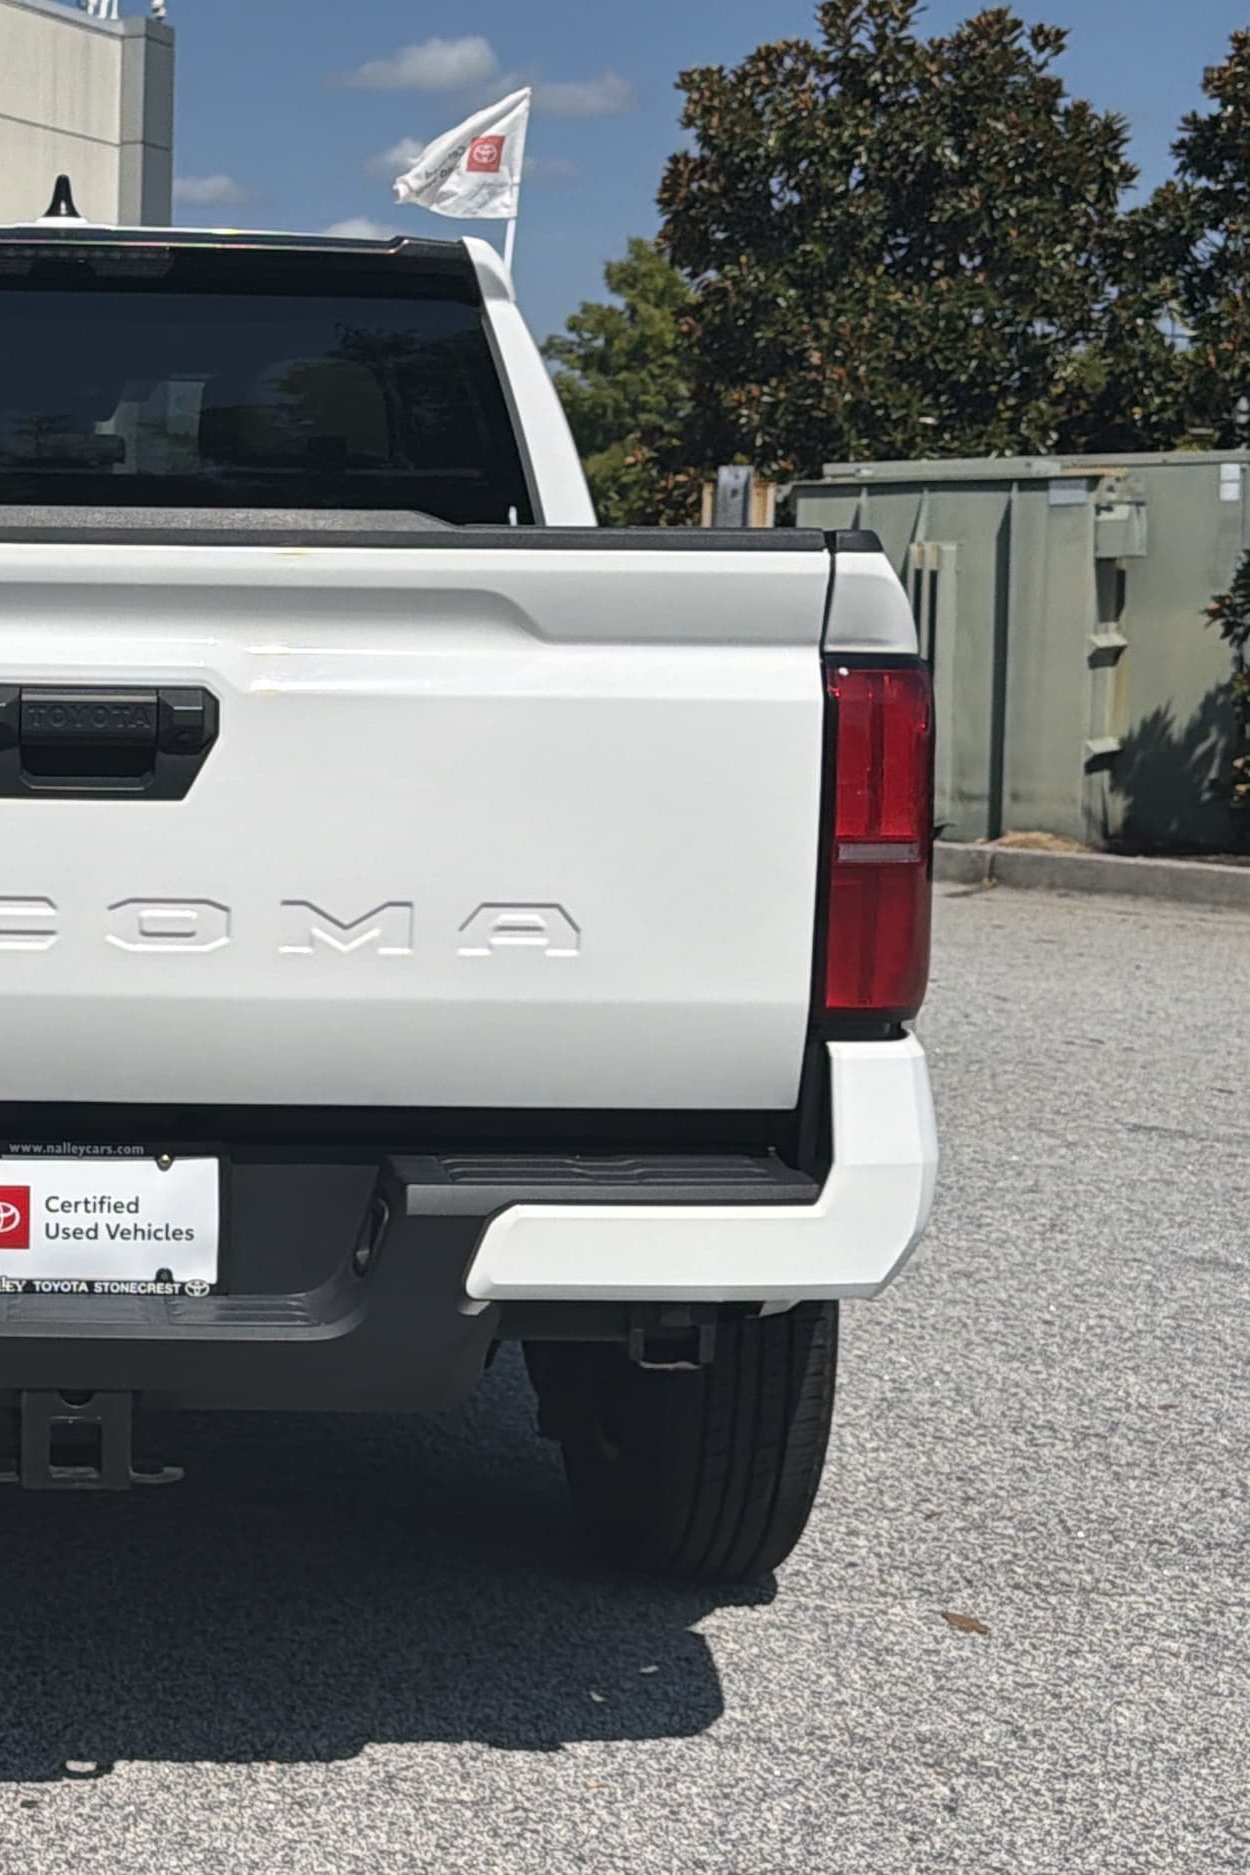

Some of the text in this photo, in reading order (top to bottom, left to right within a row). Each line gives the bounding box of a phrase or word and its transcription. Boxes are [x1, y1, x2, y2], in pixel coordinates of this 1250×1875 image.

[27, 704, 151, 729] TOYOTA
[9, 1142, 144, 1156] www.nalleycars.com
[44, 1196, 140, 1215] Certified
[44, 1222, 195, 1242] Used Vehicles
[34, 1280, 88, 1293] TOYOTA
[94, 1282, 181, 1295] STONECREST
